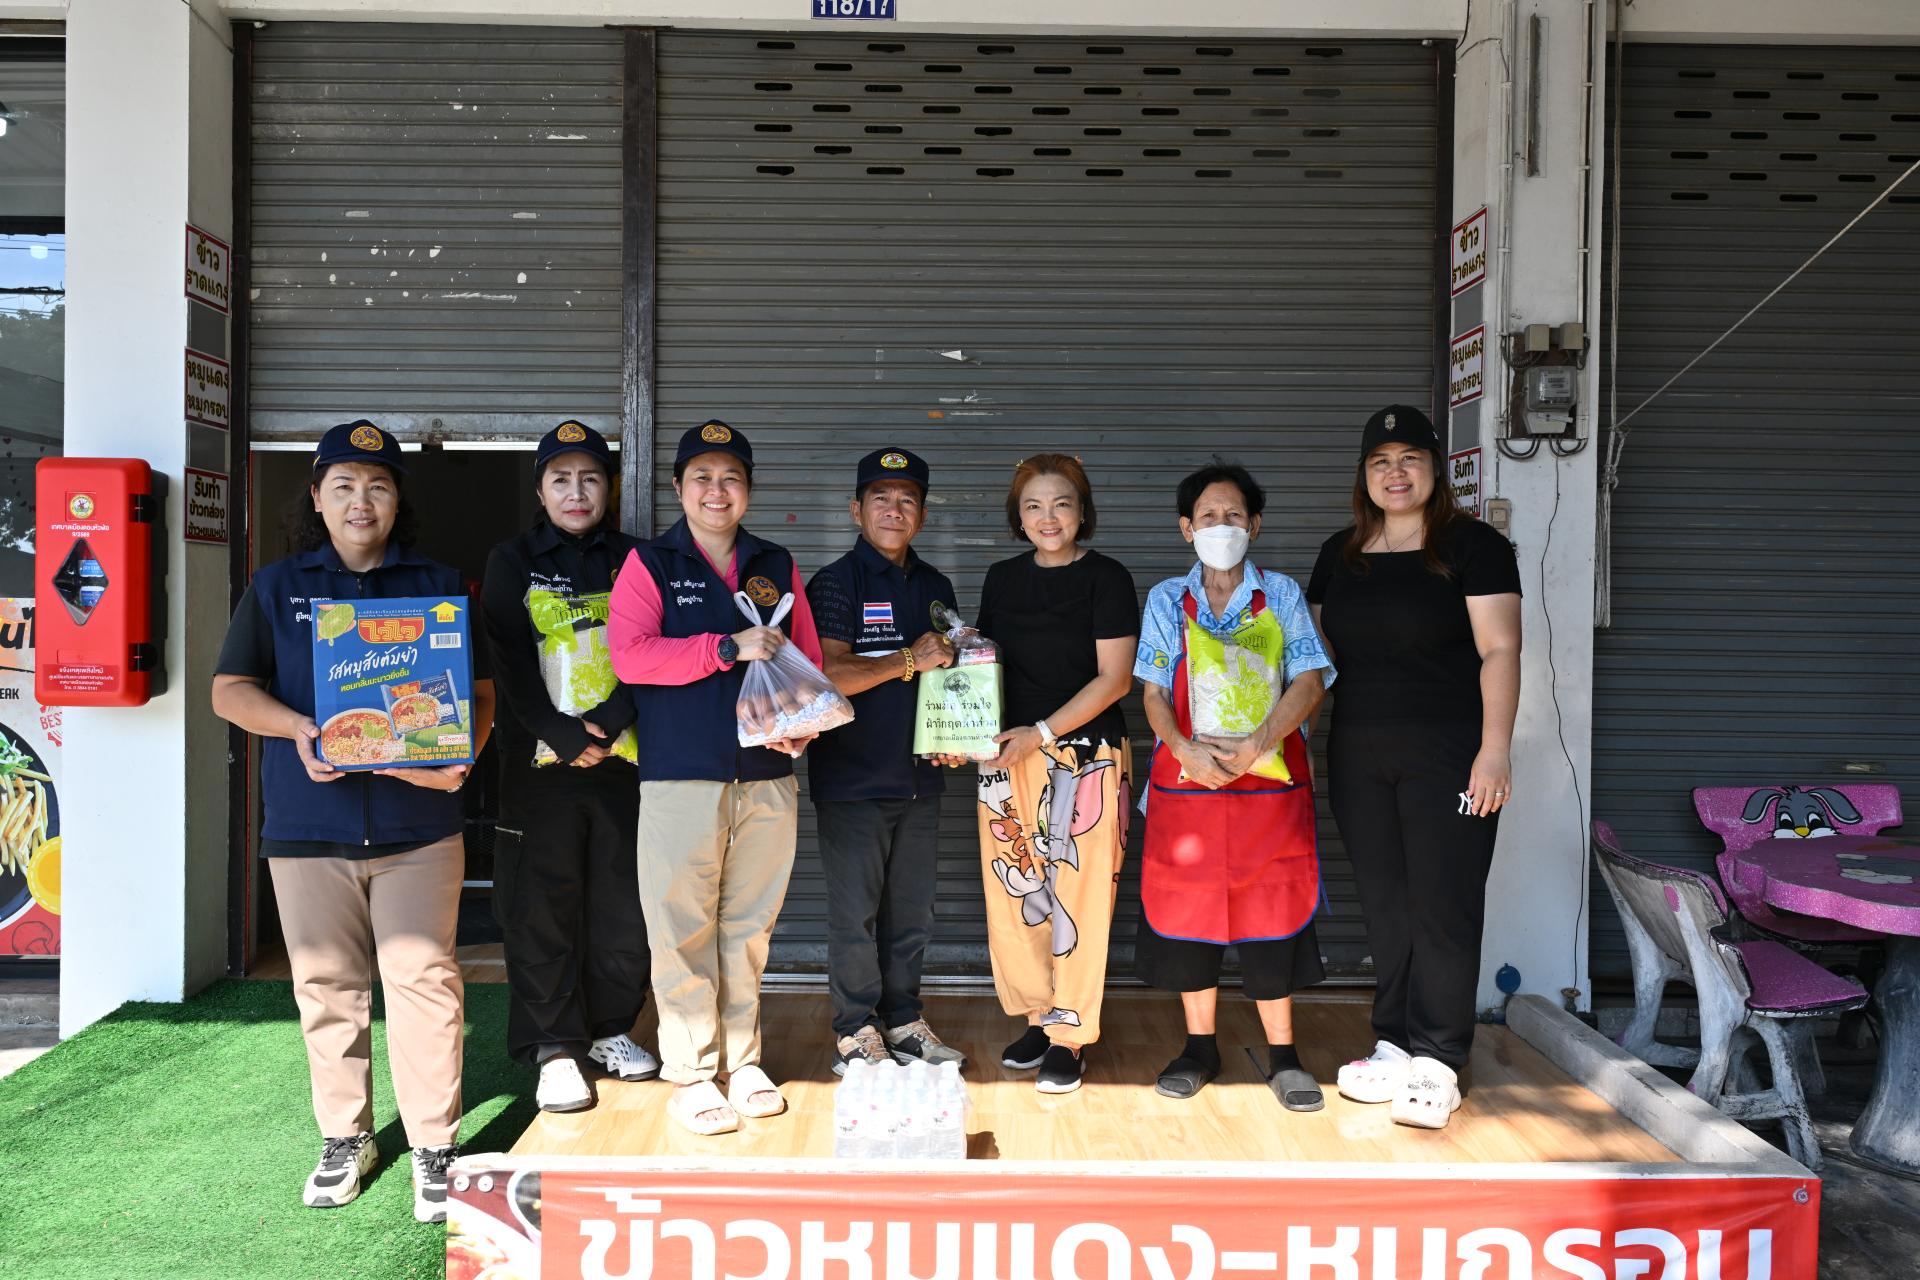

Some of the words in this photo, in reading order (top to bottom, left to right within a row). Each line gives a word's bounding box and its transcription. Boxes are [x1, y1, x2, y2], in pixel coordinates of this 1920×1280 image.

[196, 233, 220, 271] ข้าว
[1460, 224, 1479, 252] ข้าว
[1452, 251, 1485, 283] ราดแกง
[186, 268, 229, 300] ราดแกง
[1451, 337, 1483, 372] หมูแดง
[186, 361, 229, 392] หมูแดง
[1451, 372, 1482, 400] หมูกรอบ
[186, 394, 228, 419] หมูกรอบ
[1454, 455, 1474, 479] รับทำ
[194, 475, 220, 500] รับทำ
[1452, 480, 1478, 498] ้าวกล่อง
[190, 498, 226, 520] ข้าวกล่อง
[328, 645, 418, 682] รสหมูสับต้มยำ
[961, 696, 992, 709] ร่วมใจ
[40, 711, 62, 735] BES
